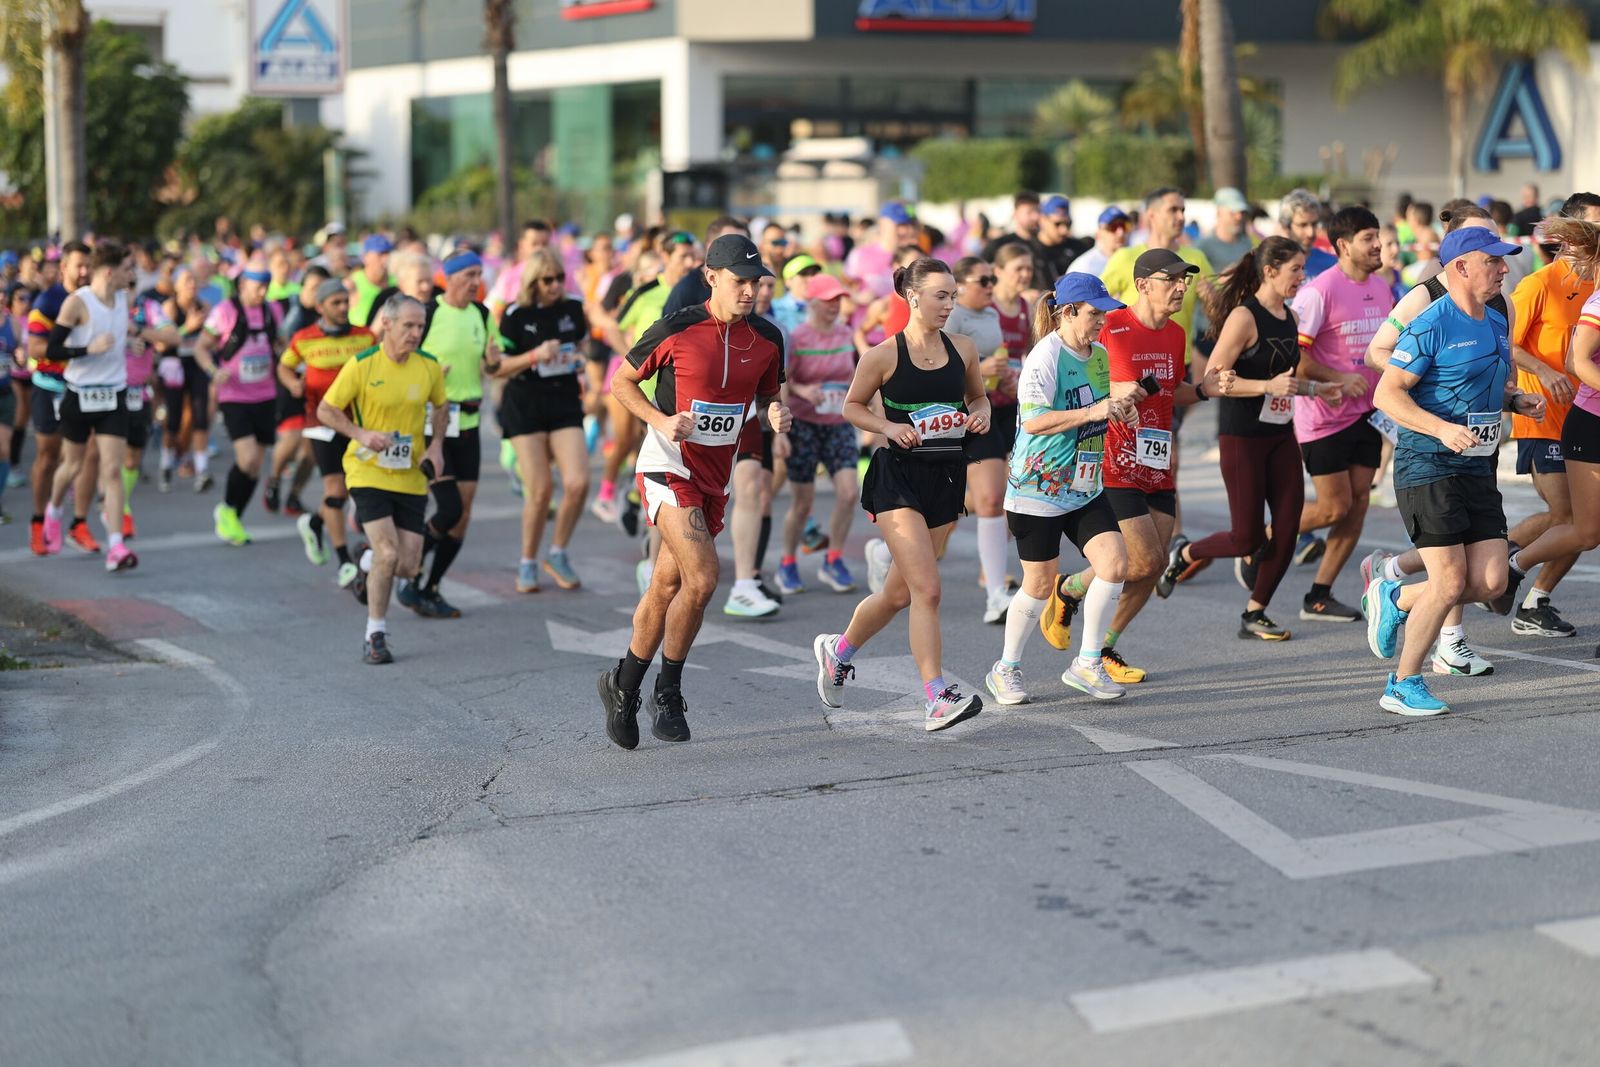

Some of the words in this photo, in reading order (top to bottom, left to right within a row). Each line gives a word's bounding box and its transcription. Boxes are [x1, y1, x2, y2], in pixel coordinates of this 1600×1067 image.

[1457, 339, 1478, 348] BROOKS
[1270, 397, 1292, 413] 594
[697, 415, 735, 432] 360
[918, 411, 965, 436] 1493
[1143, 440, 1168, 458] 794
